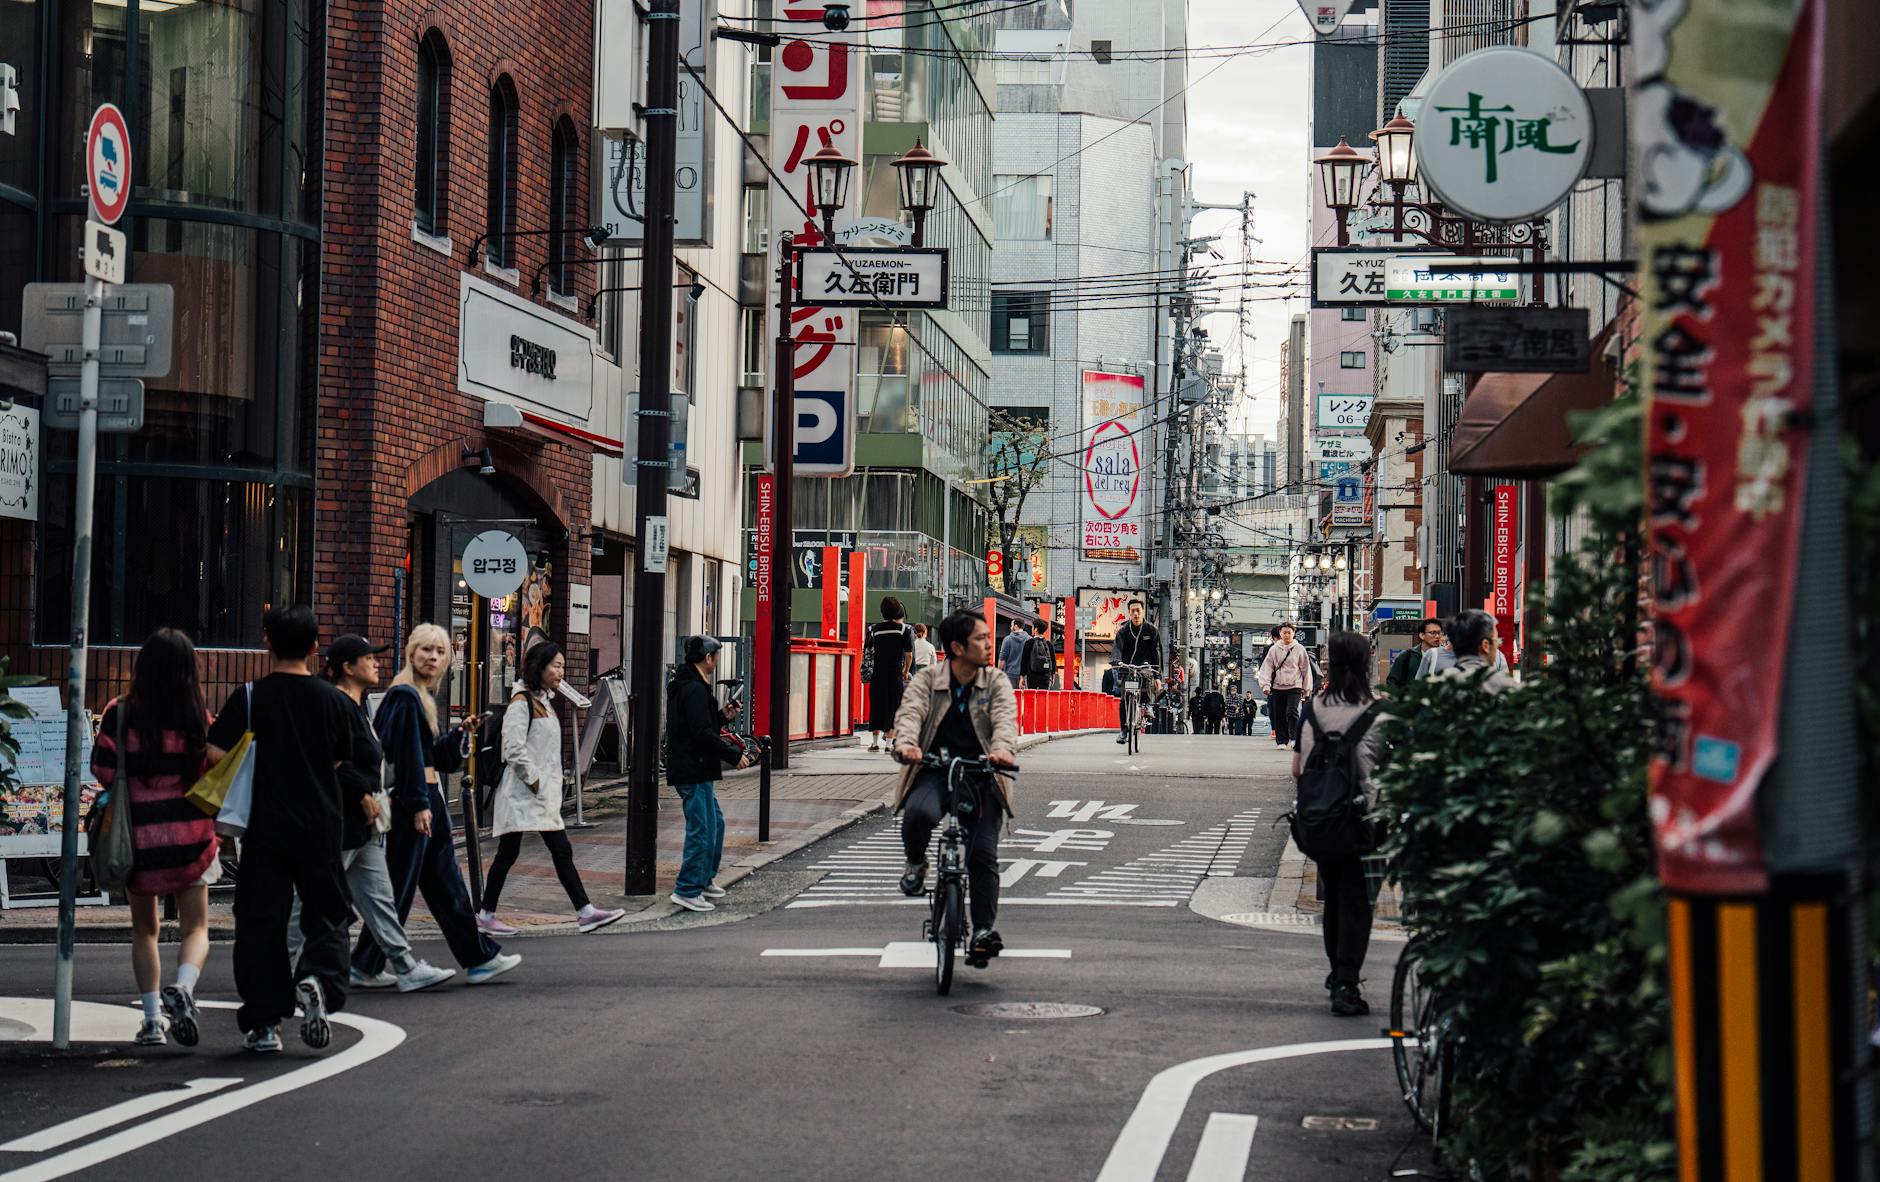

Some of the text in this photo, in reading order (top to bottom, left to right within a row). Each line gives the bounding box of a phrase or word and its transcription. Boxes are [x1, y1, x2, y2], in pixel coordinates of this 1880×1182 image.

[1433, 91, 1582, 184] 南風
[609, 165, 698, 190] PRO
[842, 223, 905, 241] クリーンミナミ
[1356, 259, 1384, 268] KYUZ
[824, 271, 920, 296] 久左衛門
[1340, 271, 1384, 295] 久左
[794, 398, 838, 456] P
[1319, 440, 1342, 449] アザミ
[0, 448, 27, 476] RIMO
[1095, 452, 1130, 476] sala
[1094, 474, 1130, 495] del rey
[1085, 520, 1138, 535] 次の四ツ角を
[758, 482, 771, 602] SHIN-EBISU BRIDGE
[1085, 534, 1121, 547] 右に入る
[1496, 491, 1509, 615] SHIN-EBISU BRIDGE
[472, 558, 517, 575] 압구정
